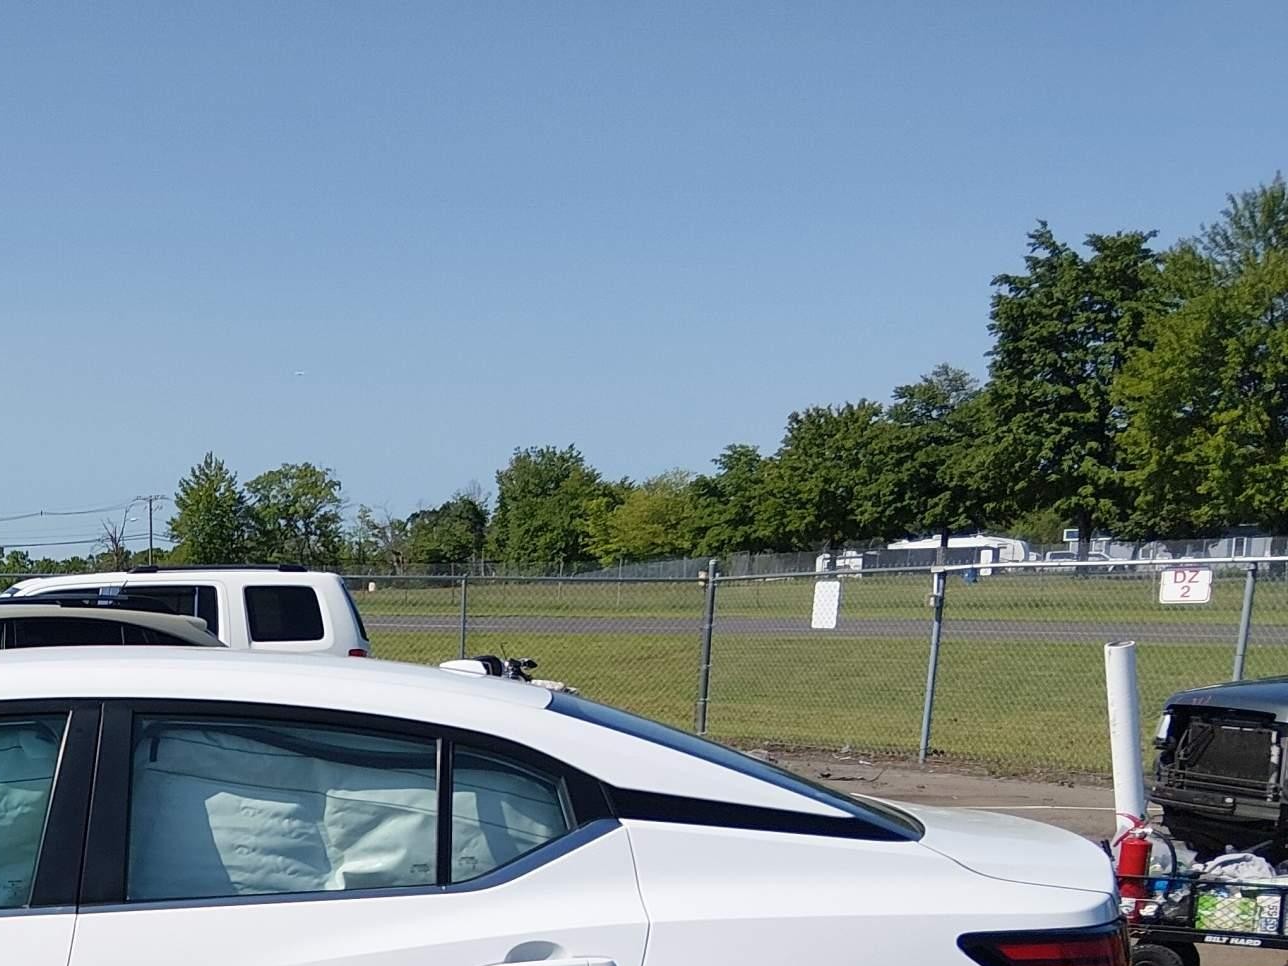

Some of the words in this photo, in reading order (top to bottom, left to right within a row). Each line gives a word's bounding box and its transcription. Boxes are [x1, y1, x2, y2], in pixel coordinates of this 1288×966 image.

[1174, 570, 1200, 584] DZ
[1179, 585, 1191, 598] 2
[1230, 938, 1262, 946] HARD
